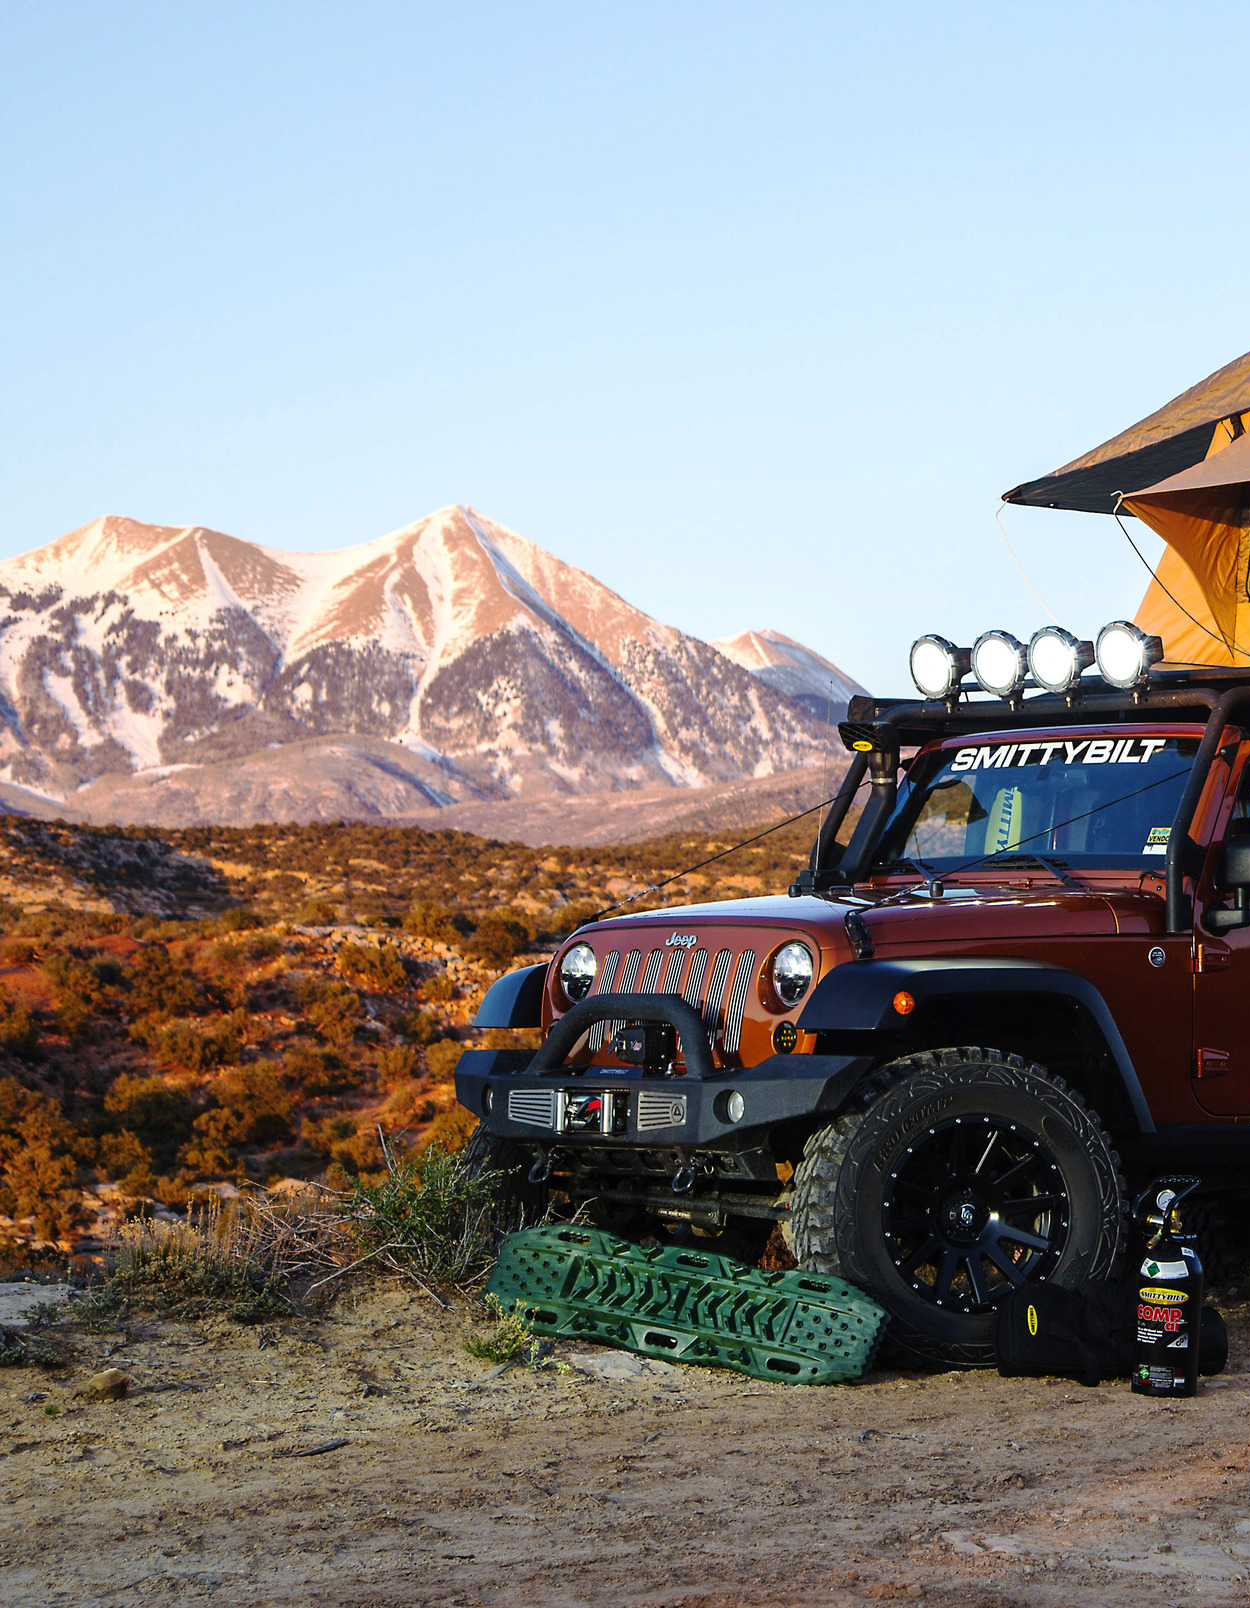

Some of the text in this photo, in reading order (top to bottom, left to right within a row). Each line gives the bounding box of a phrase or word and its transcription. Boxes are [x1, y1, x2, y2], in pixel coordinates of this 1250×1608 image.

[950, 739, 1166, 772] SMITTYBILT
[665, 931, 698, 949] Jeep
[1141, 1291, 1186, 1302] SMITTYBILT
[1137, 1304, 1182, 1322] COMP
